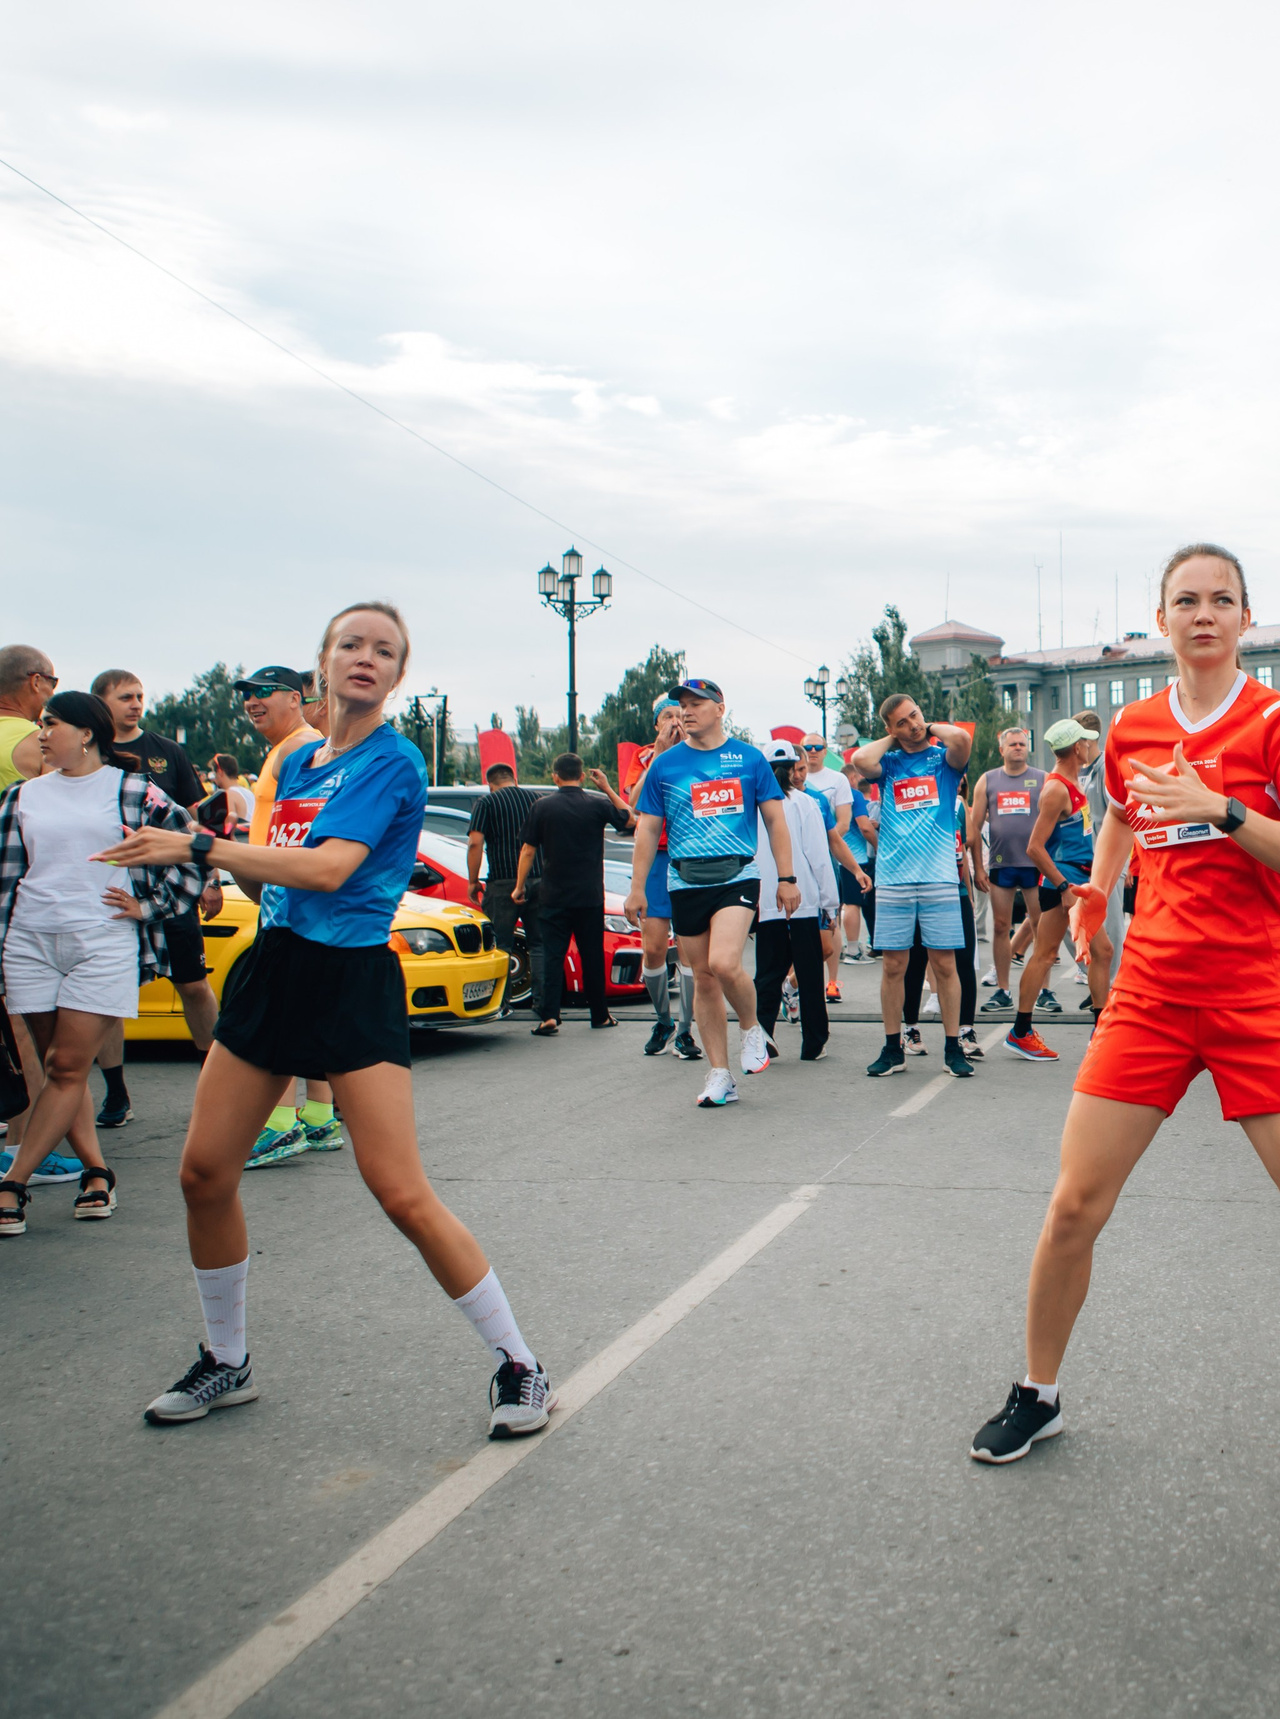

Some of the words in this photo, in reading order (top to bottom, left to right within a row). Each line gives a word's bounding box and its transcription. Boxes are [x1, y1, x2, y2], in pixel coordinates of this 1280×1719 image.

[720, 751, 743, 760] SIM
[700, 789, 735, 805] 2491
[901, 785, 929, 799] 1861
[1002, 797, 1025, 806] 2186
[270, 821, 312, 847] 2422
